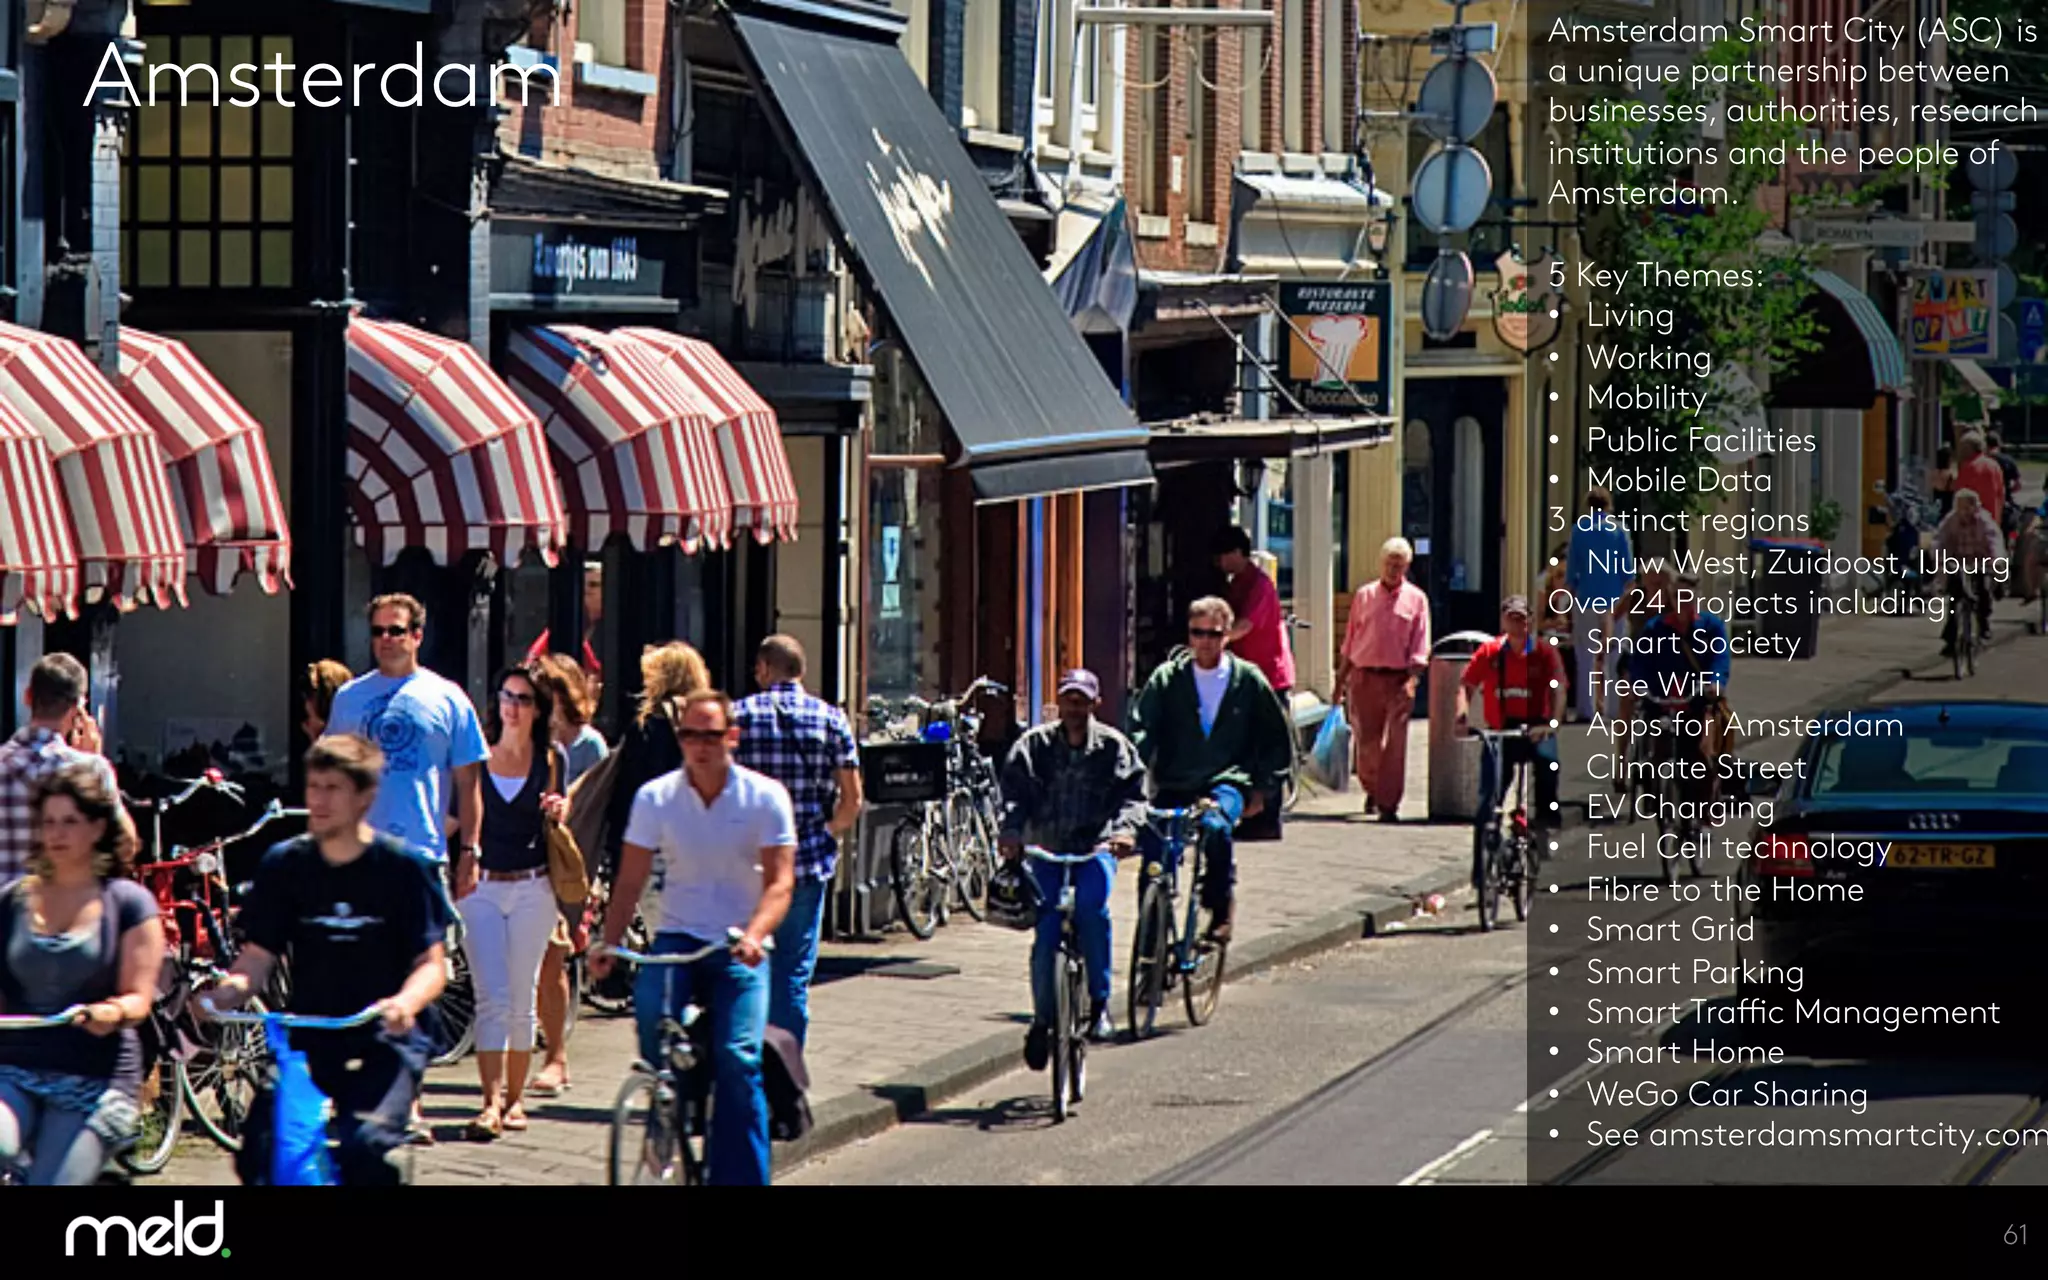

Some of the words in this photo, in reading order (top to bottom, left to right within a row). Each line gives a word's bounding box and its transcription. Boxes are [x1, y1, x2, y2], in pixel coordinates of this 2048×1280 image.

[1297, 286, 1377, 300] RISTORANTE
[1914, 278, 1988, 300] ZWART
[1306, 301, 1367, 312] PIZZERIA
[1913, 316, 1942, 341] OP
[1893, 846, 1987, 865] 62-TR-GZ
